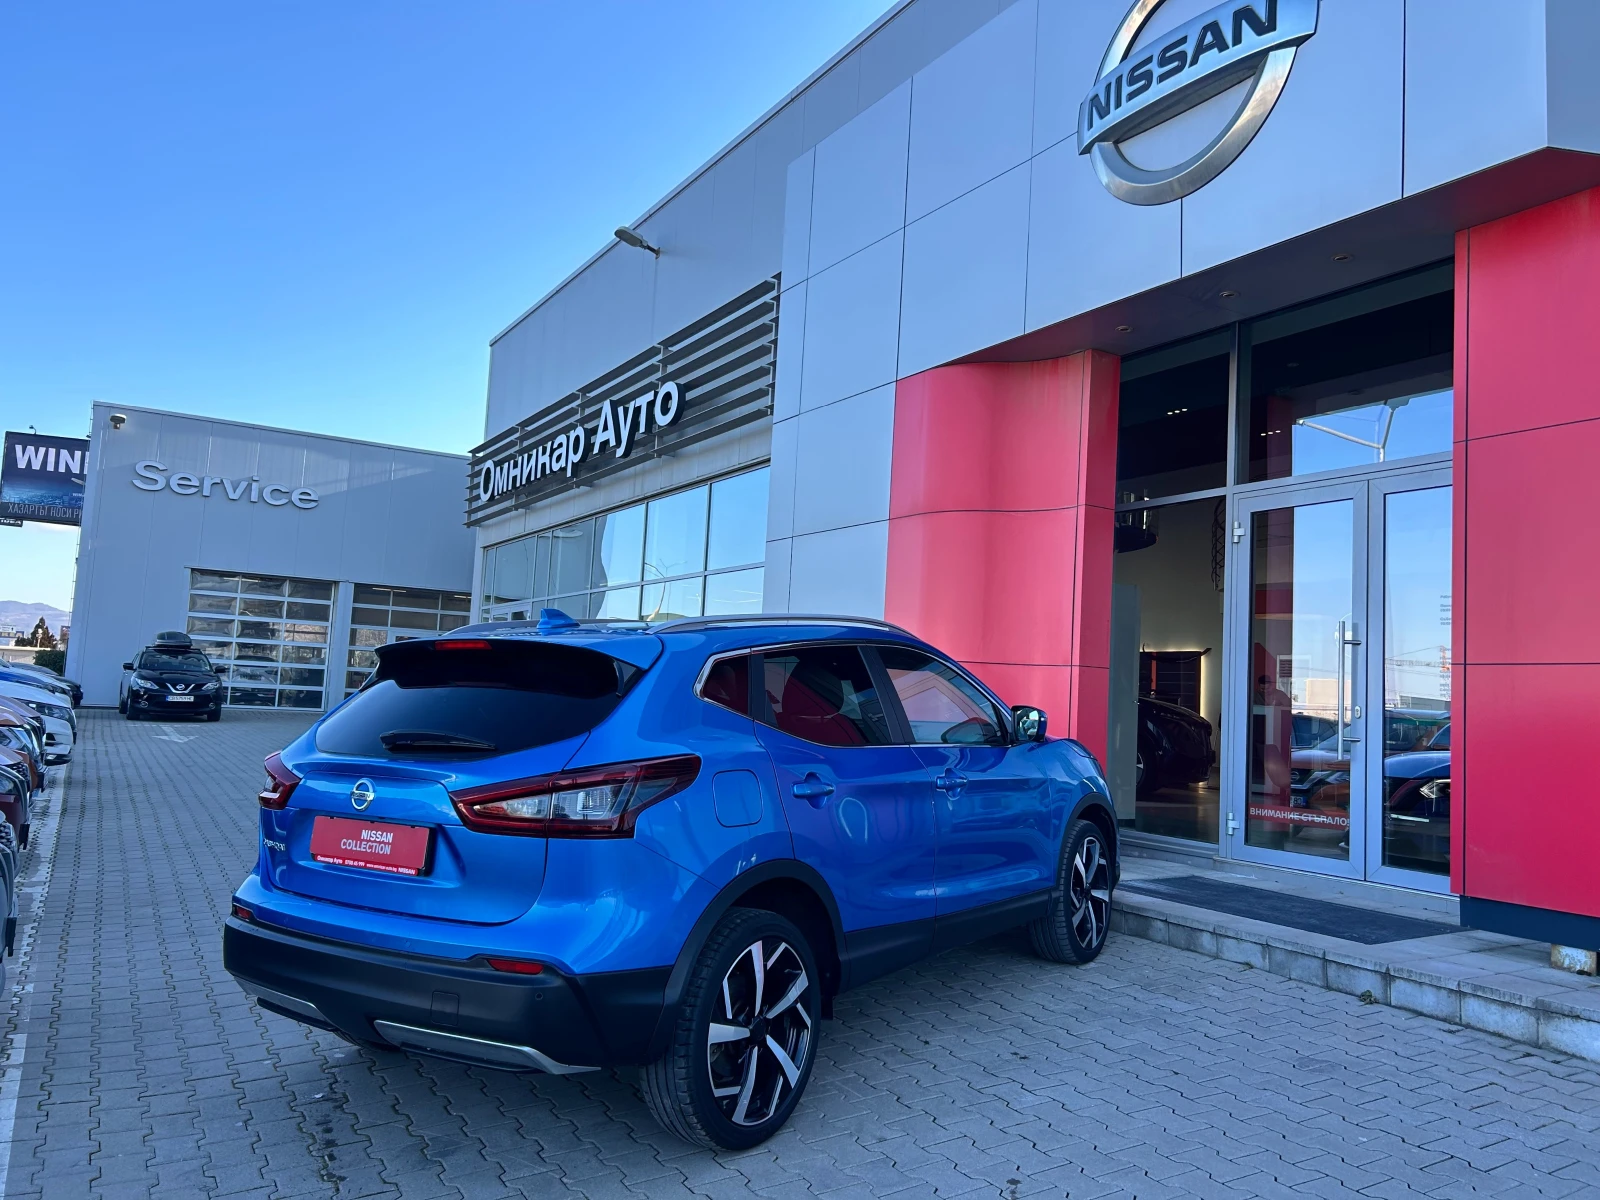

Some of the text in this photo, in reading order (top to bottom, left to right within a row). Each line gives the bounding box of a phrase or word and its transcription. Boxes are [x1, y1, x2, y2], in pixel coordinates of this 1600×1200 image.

[1087, 0, 1277, 131] NISSAN
[480, 381, 681, 501] Омникар Ауто
[132, 460, 319, 509] Service
[8, 502, 48, 516] ХАЗАРТЪТ
[50, 506, 72, 518] НОСИ
[1250, 807, 1300, 820] ВНИМАНИЕ
[361, 829, 394, 843] NISSAN
[340, 838, 392, 855] COLLECTION
